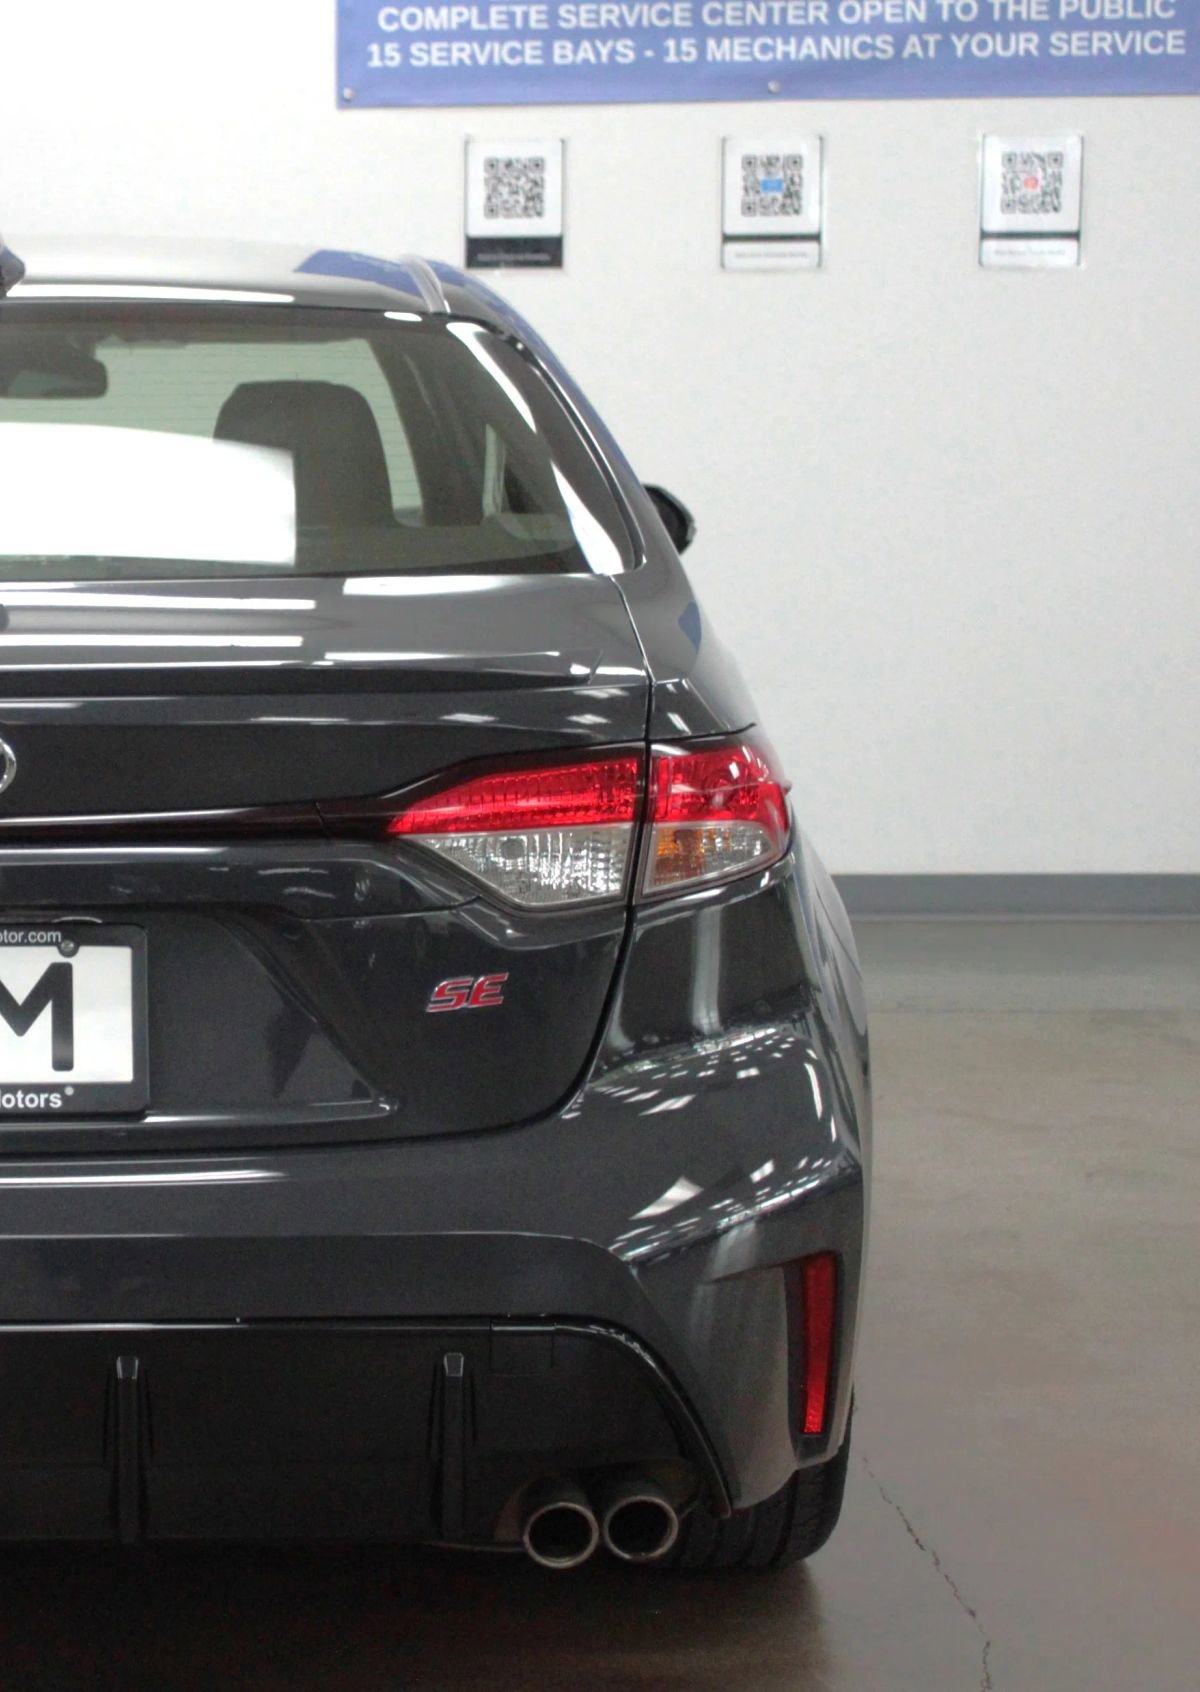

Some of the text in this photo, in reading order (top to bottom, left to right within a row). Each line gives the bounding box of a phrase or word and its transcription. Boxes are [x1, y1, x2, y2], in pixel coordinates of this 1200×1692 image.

[377, 0, 1176, 32] COMPLETE SERVICE CENTER OPEN TO THE PUBLIC
[367, 42, 401, 67] 15
[409, 40, 543, 66] SERVICE
[552, 38, 635, 64] BAYS
[663, 37, 698, 63] 15
[706, 34, 895, 62] MECHANICS
[902, 33, 942, 58] AT
[950, 31, 1040, 58] YOUR
[1049, 29, 1186, 56] SERVICE
[425, 972, 510, 1013] SE
